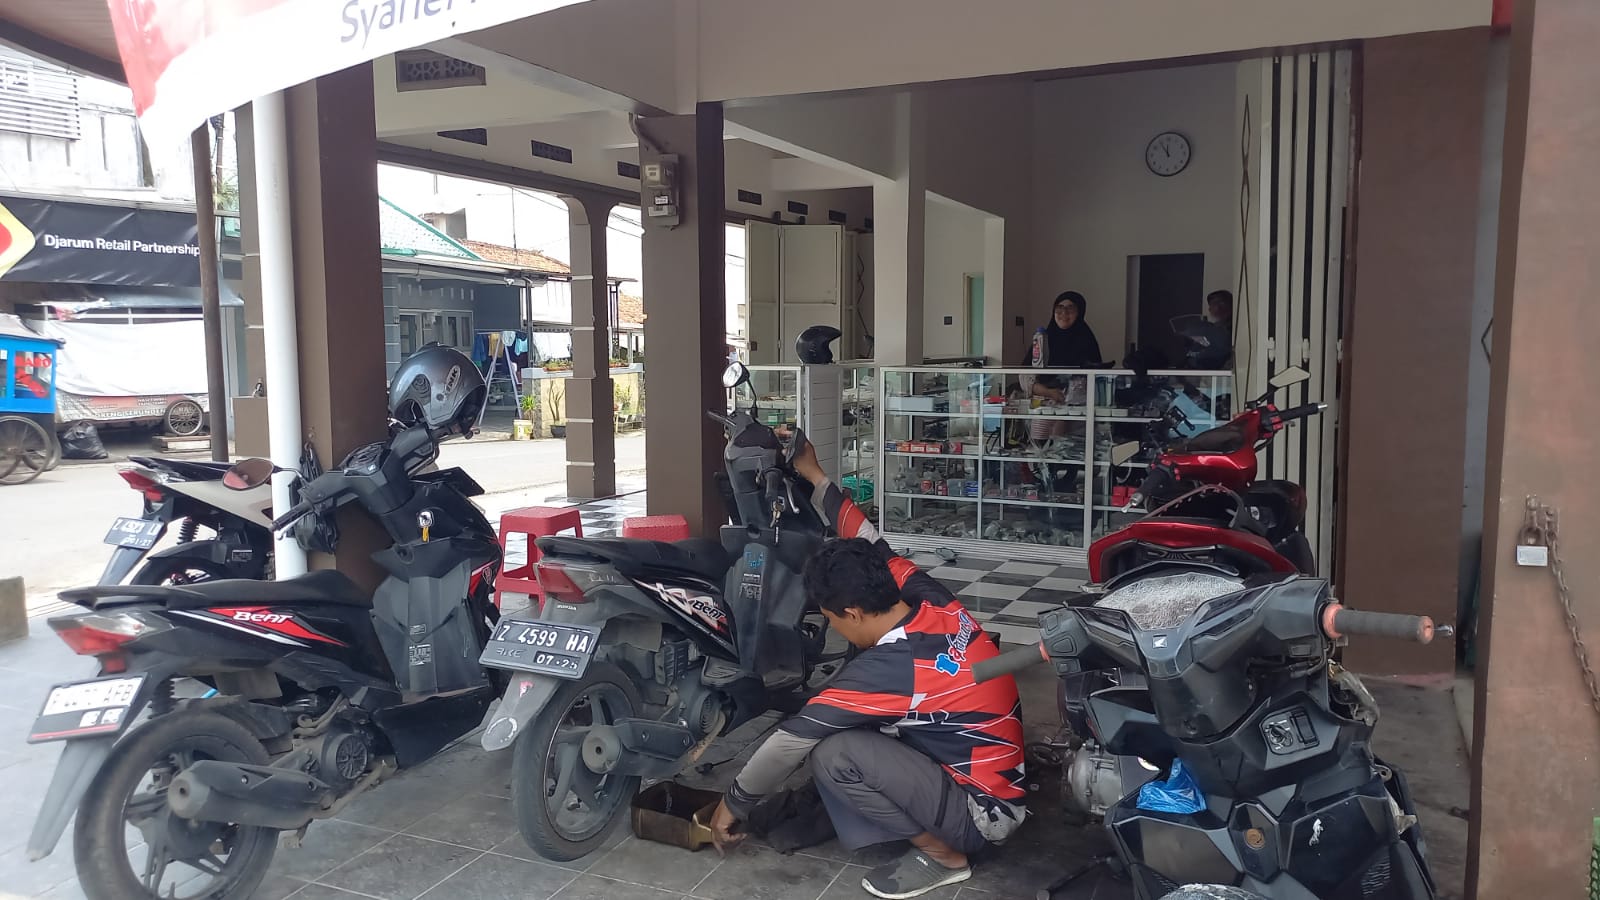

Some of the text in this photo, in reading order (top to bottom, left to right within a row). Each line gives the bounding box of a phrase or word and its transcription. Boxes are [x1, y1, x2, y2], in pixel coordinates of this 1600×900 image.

[44, 234, 200, 257] Djarum Retail Partnership
[496, 625, 589, 652] Z 4599 HA
